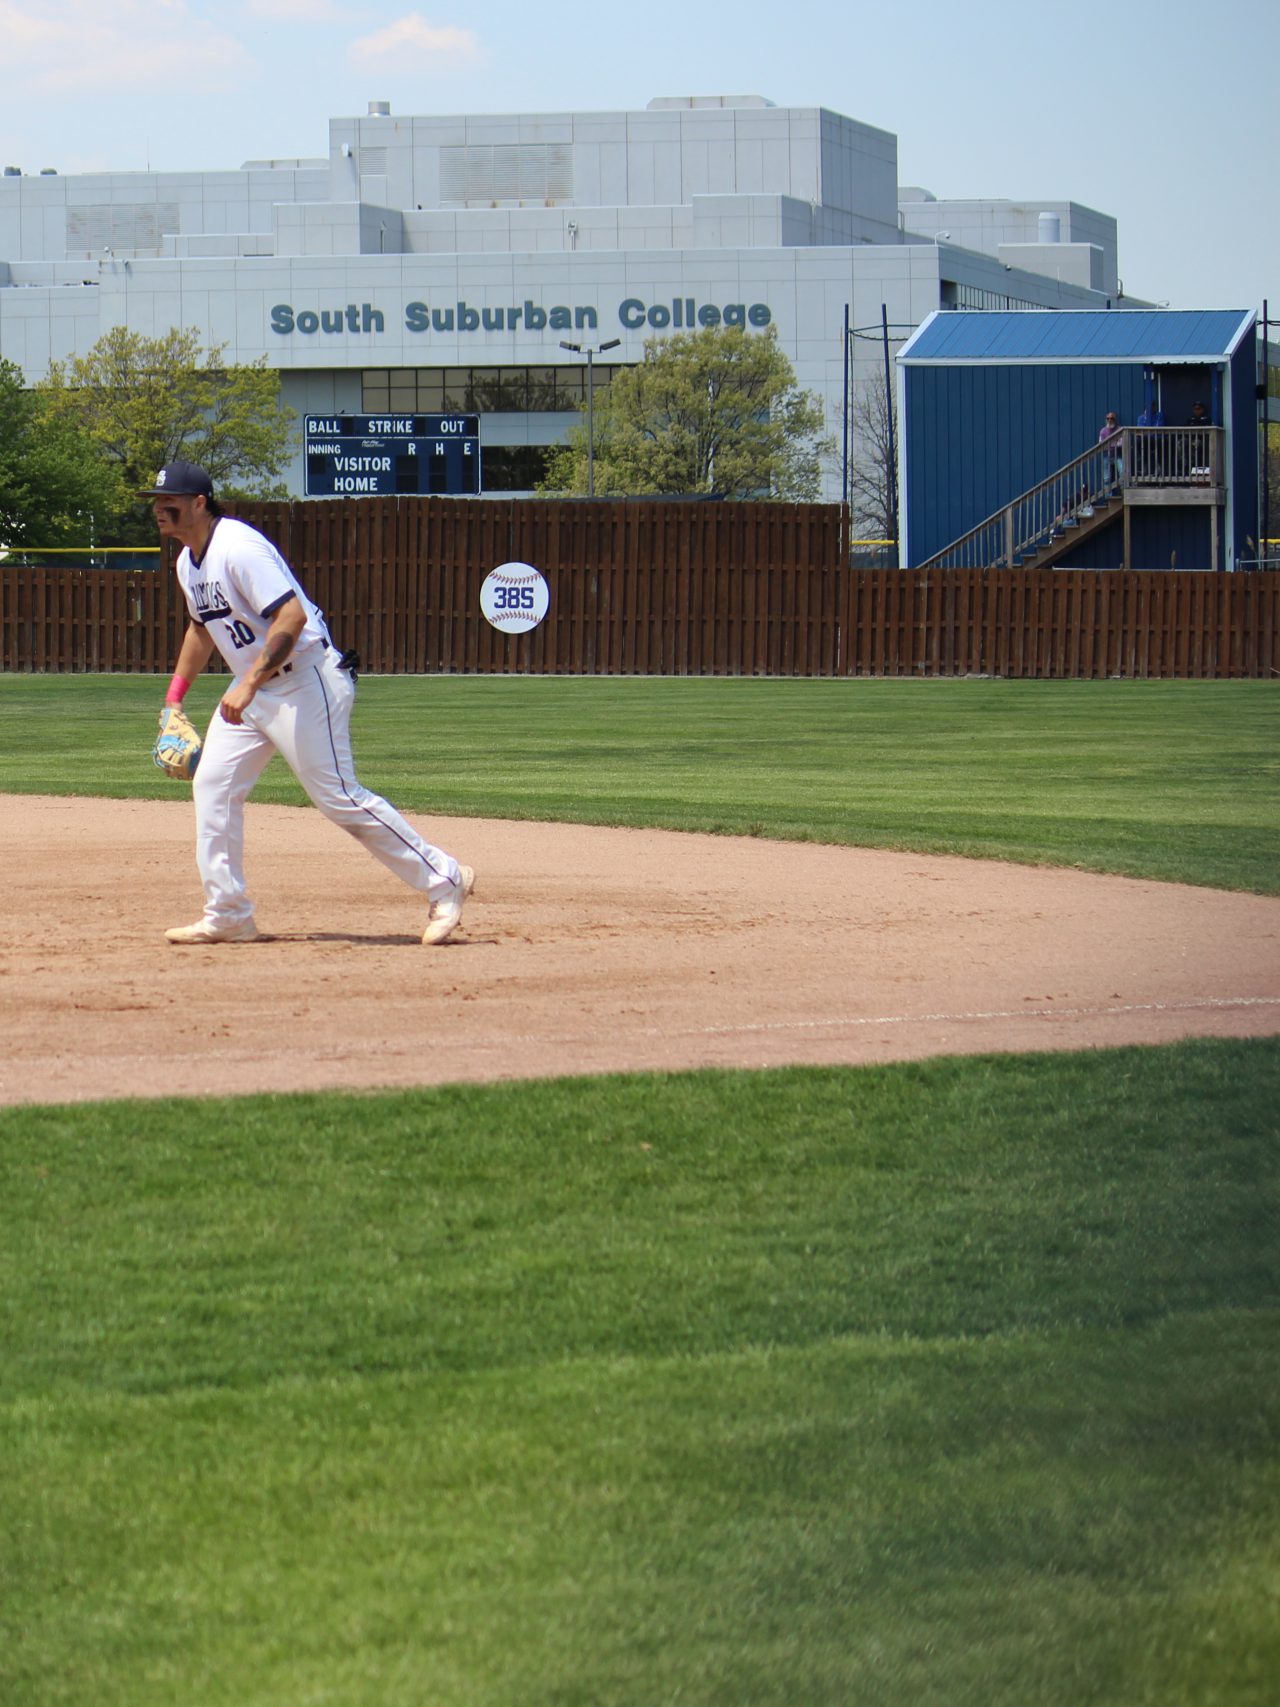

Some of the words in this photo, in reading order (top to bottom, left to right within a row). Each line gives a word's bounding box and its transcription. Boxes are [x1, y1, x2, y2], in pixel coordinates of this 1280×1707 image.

[270, 303, 384, 335] South
[405, 300, 598, 333] Suburban
[618, 298, 772, 333] College
[308, 421, 340, 433] BALL
[368, 420, 413, 433] STRIKE
[440, 420, 464, 433] OUT
[308, 444, 341, 454] INNING
[408, 443, 416, 455] R
[435, 443, 444, 455] H
[463, 443, 471, 455] E
[334, 457, 391, 471] VISITOR
[334, 477, 378, 491] HOME
[493, 587, 534, 609] 385
[225, 619, 256, 650] 20
